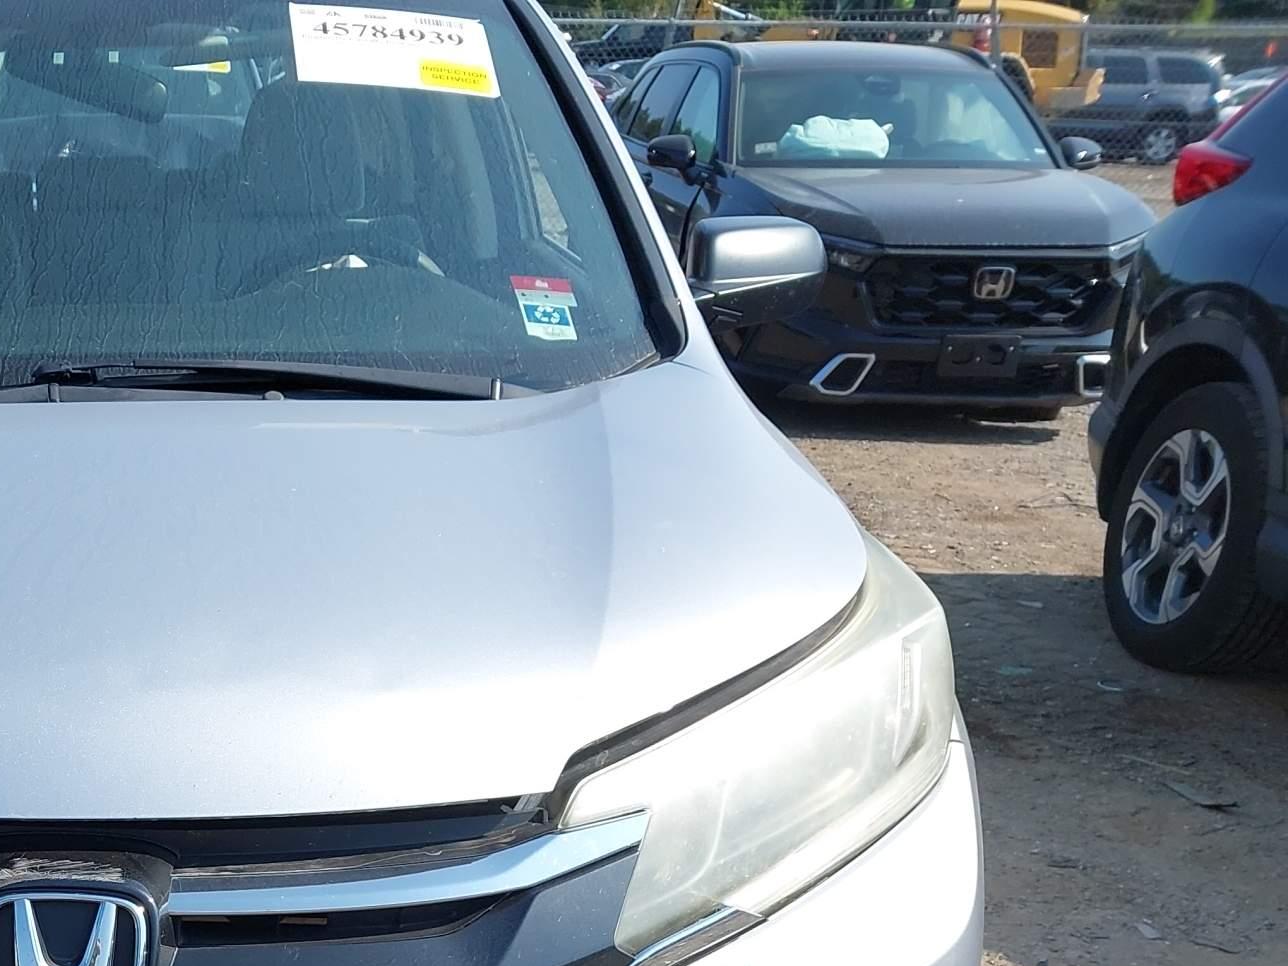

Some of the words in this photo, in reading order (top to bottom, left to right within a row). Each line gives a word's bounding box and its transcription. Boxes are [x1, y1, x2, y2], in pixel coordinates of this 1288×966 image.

[312, 21, 464, 46] 45784939
[422, 65, 487, 79] INSPECTION
[431, 73, 481, 85] SERVICE
